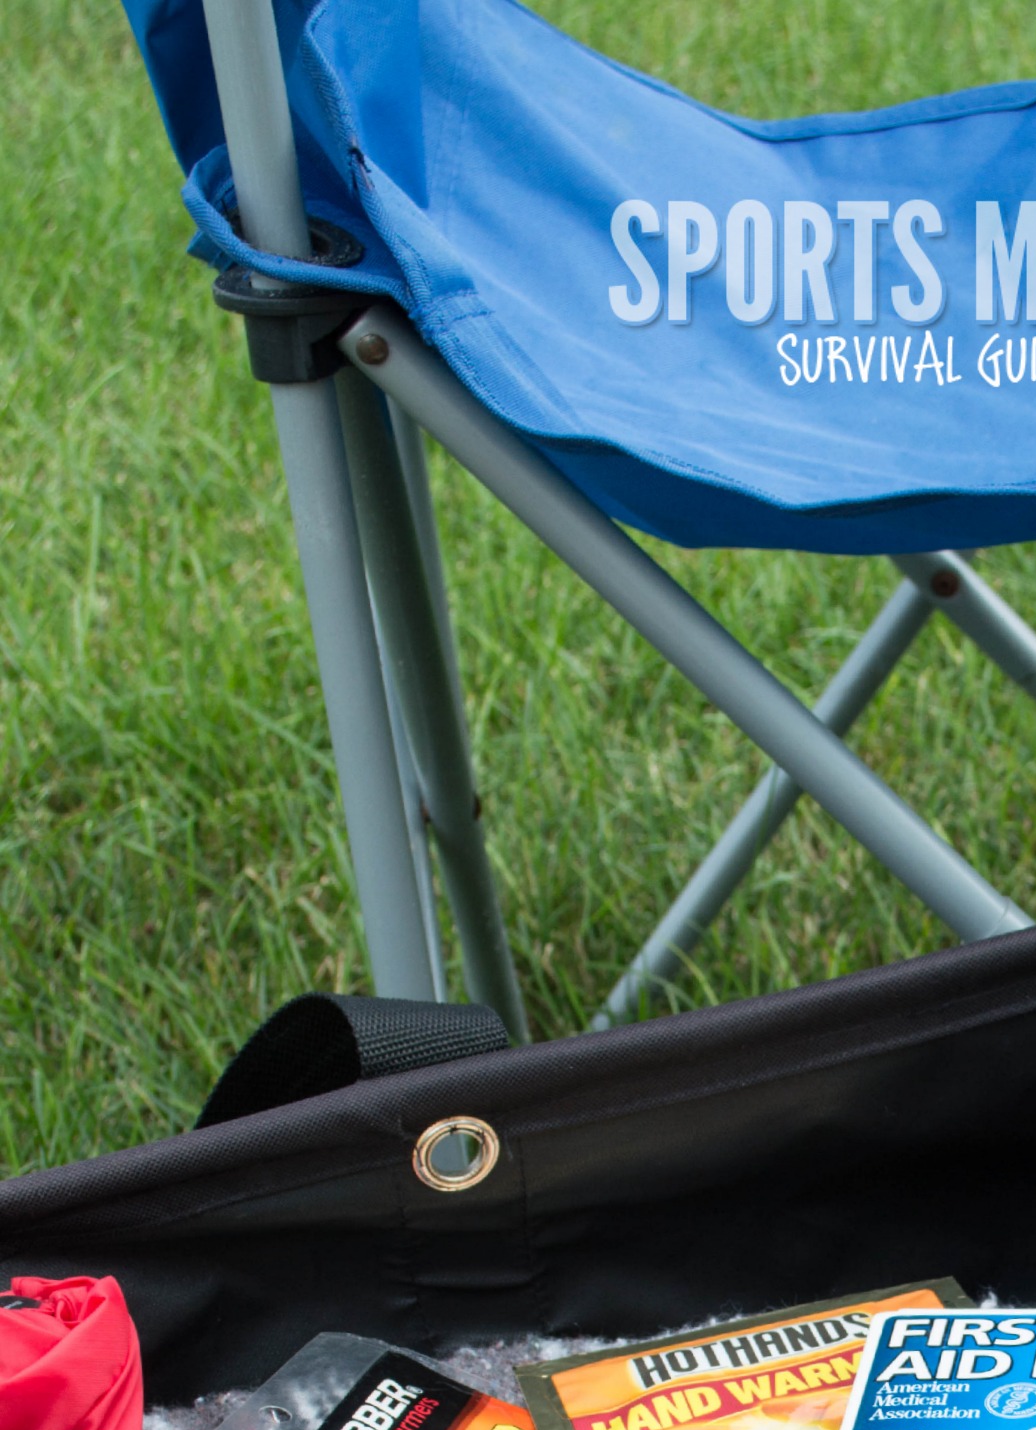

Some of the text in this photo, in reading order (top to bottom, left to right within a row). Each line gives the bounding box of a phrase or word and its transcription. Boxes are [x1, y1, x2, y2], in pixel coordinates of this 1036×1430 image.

[632, 1312, 870, 1390] HOTHANDS
[875, 1348, 1013, 1382] AID
[876, 1380, 971, 1396] American
[871, 1393, 948, 1408] Medical
[868, 1405, 981, 1421] Association
